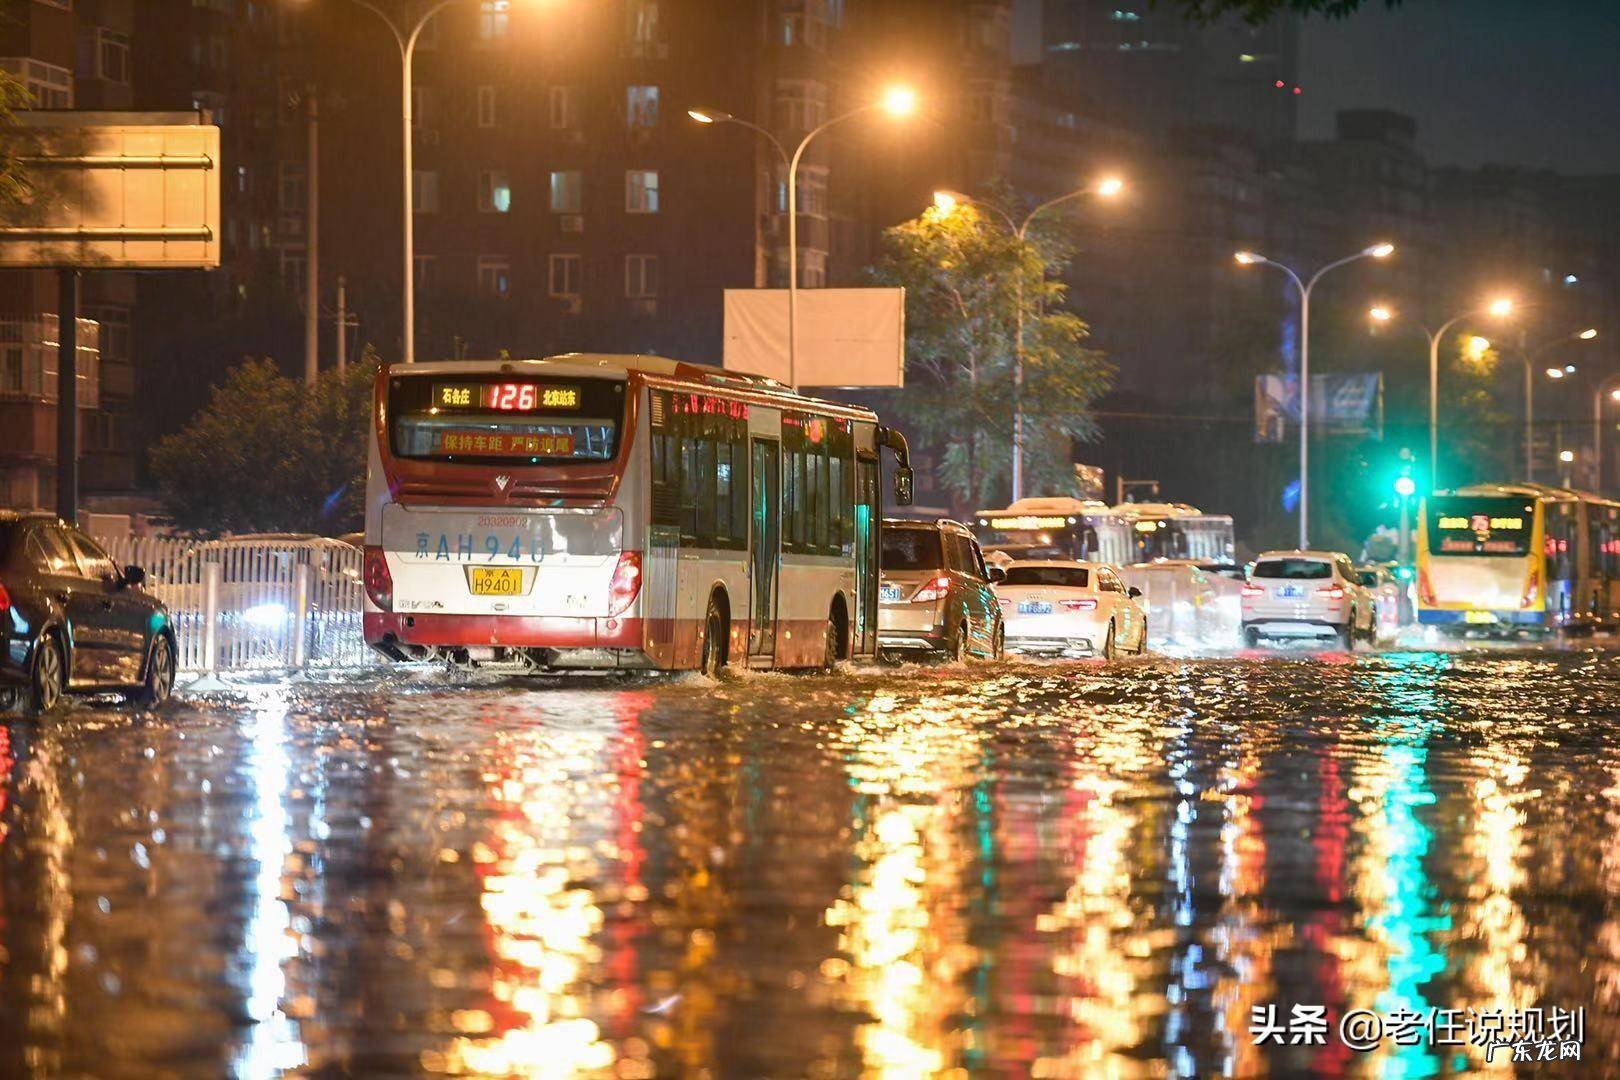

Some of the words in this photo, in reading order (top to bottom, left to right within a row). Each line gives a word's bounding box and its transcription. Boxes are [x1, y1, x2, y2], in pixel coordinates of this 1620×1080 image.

[442, 388, 470, 404] 石各庄
[491, 384, 534, 410] 126
[543, 390, 576, 406] 北京站东
[444, 434, 502, 451] 保持车距
[474, 578, 517, 592] H9401
